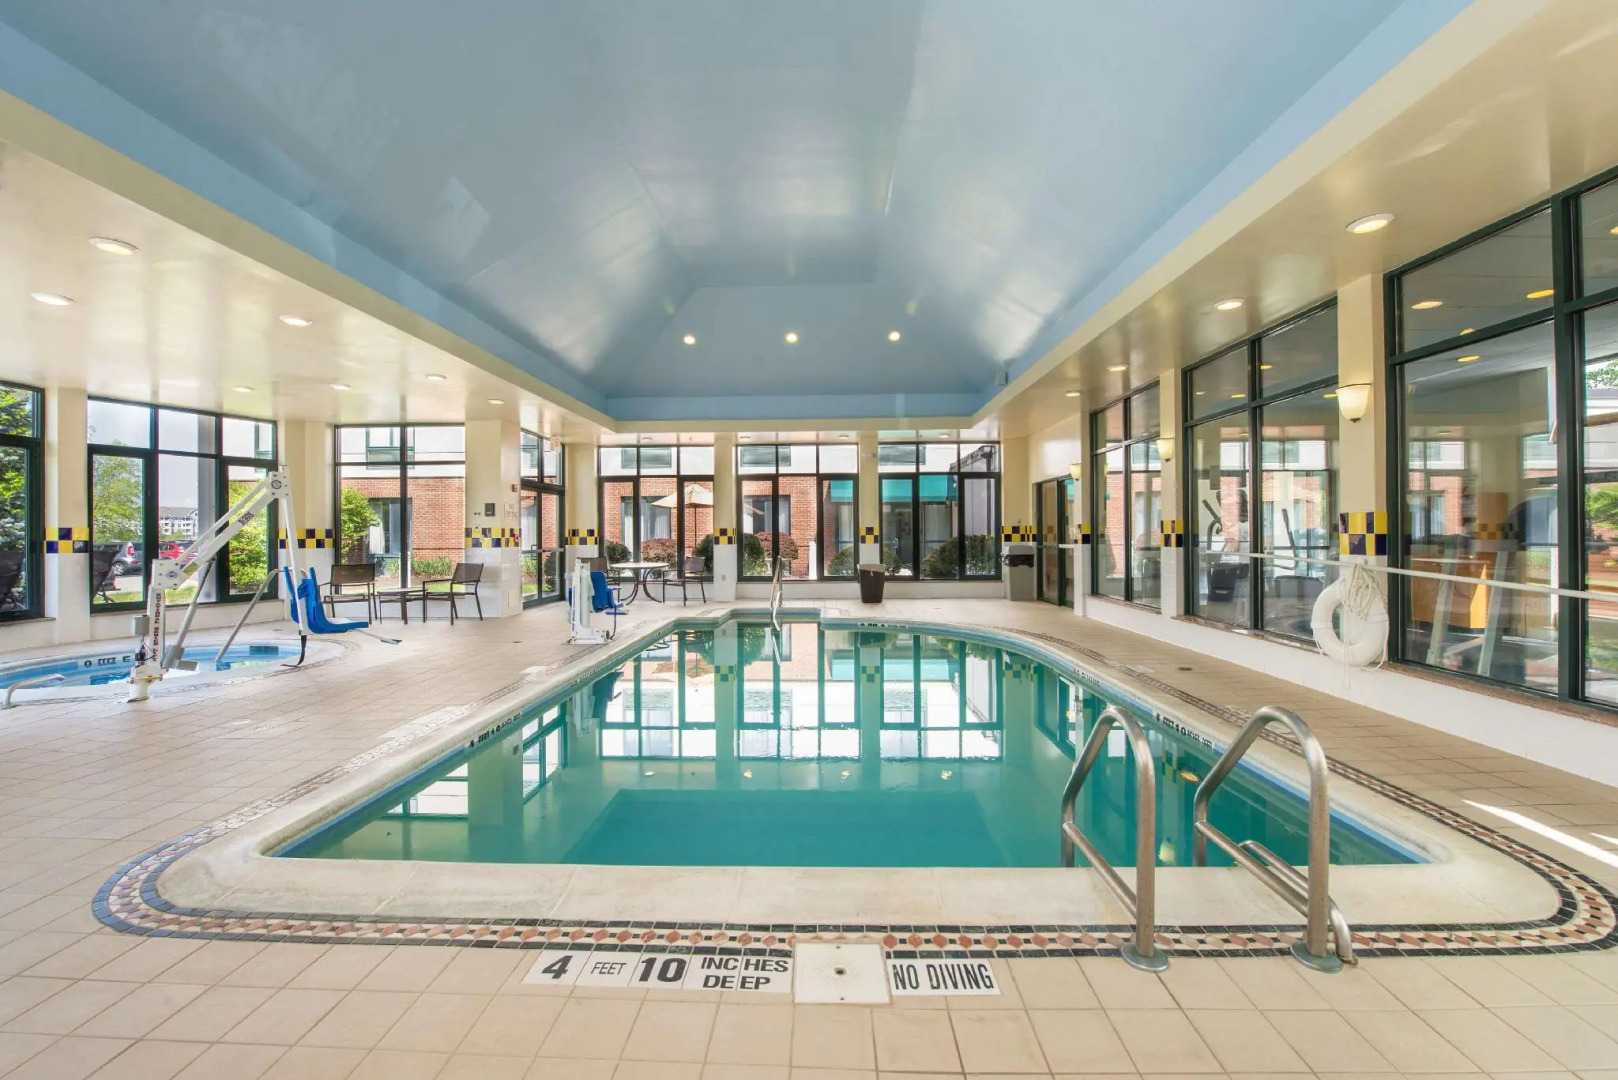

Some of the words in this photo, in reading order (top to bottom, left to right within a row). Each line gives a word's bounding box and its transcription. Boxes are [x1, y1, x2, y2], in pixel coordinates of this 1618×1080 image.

[541, 955, 573, 979] 4
[590, 961, 627, 975] FEET
[638, 957, 687, 983] 10
[701, 957, 788, 972] INCHES
[703, 975, 771, 990] DEEP
[892, 963, 920, 990] NO
[926, 963, 994, 990] DIVING
